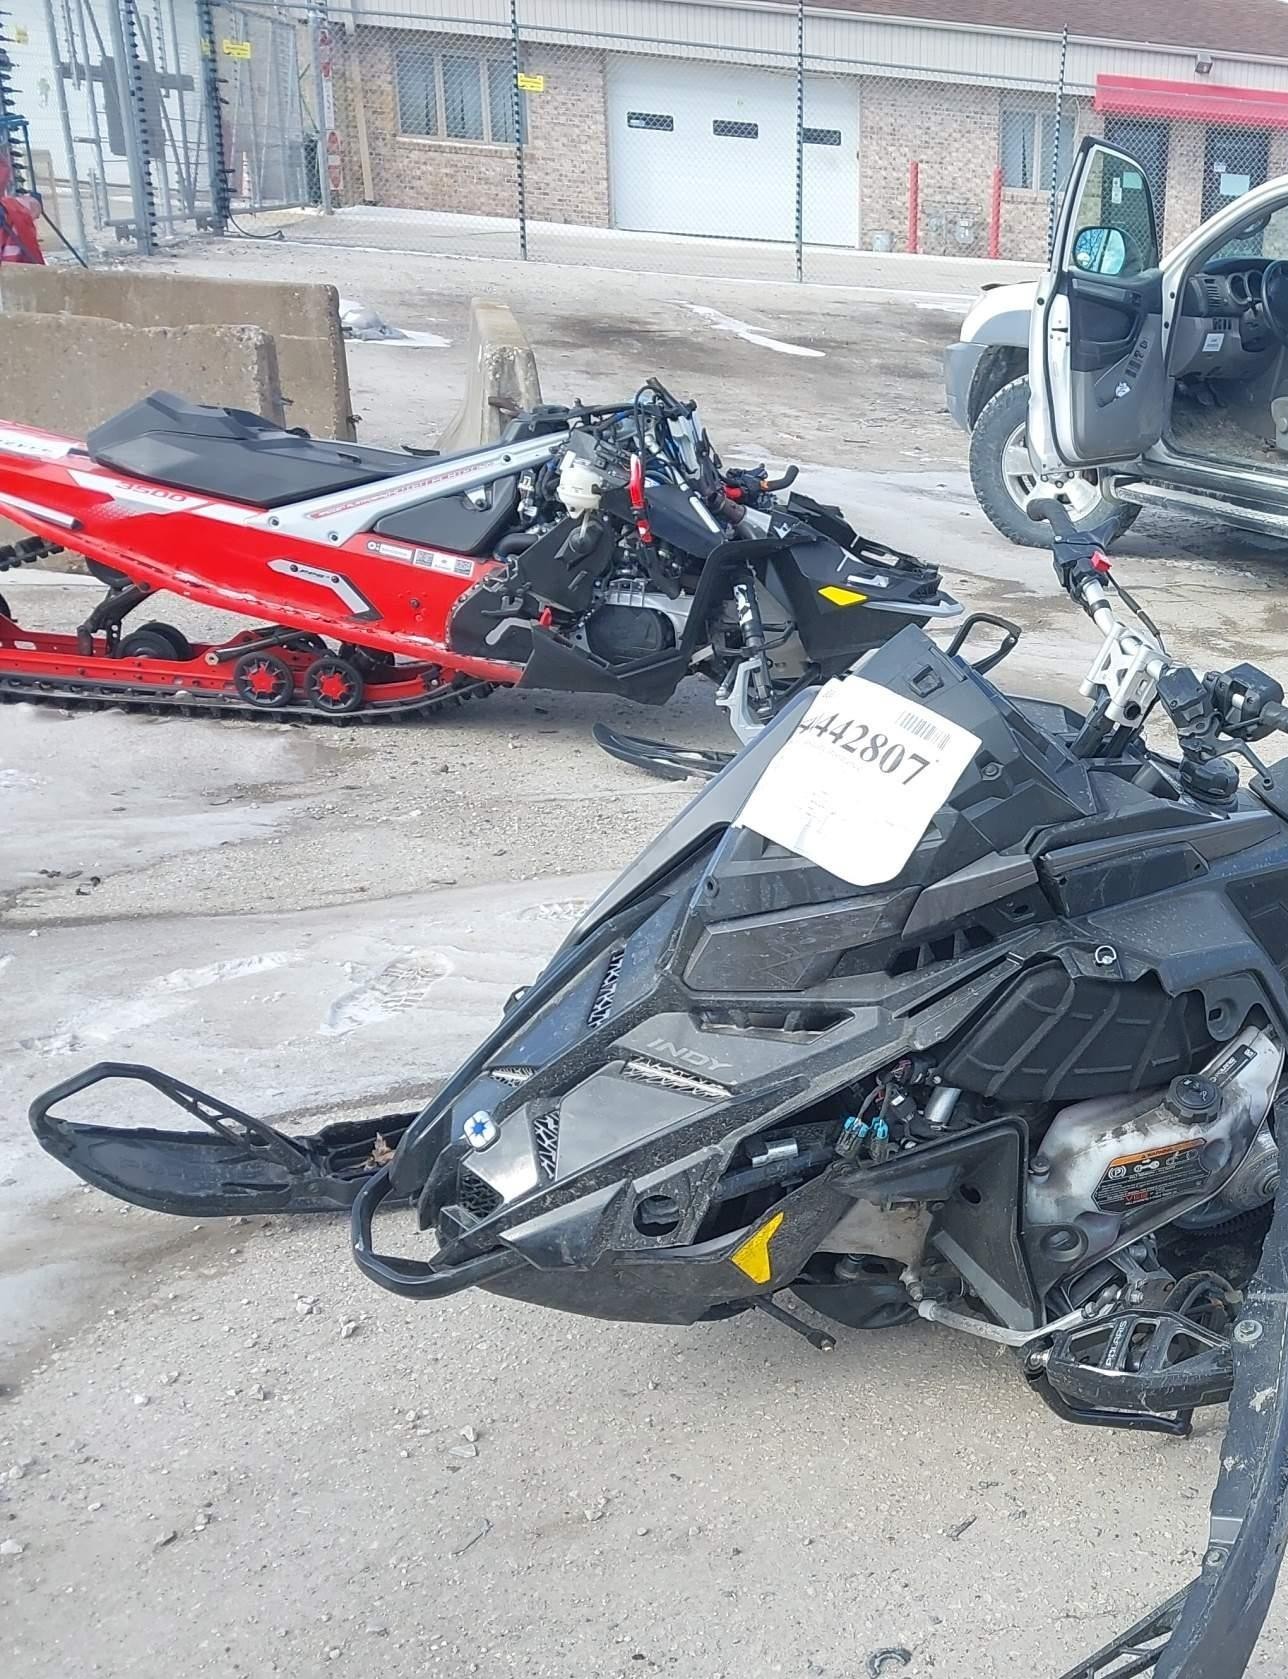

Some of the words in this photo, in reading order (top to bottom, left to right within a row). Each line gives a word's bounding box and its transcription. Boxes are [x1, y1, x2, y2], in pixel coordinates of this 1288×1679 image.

[798, 712, 931, 786] 4442807
[646, 1038, 734, 1071] INDY
[1105, 1320, 1128, 1367] POLARIS
